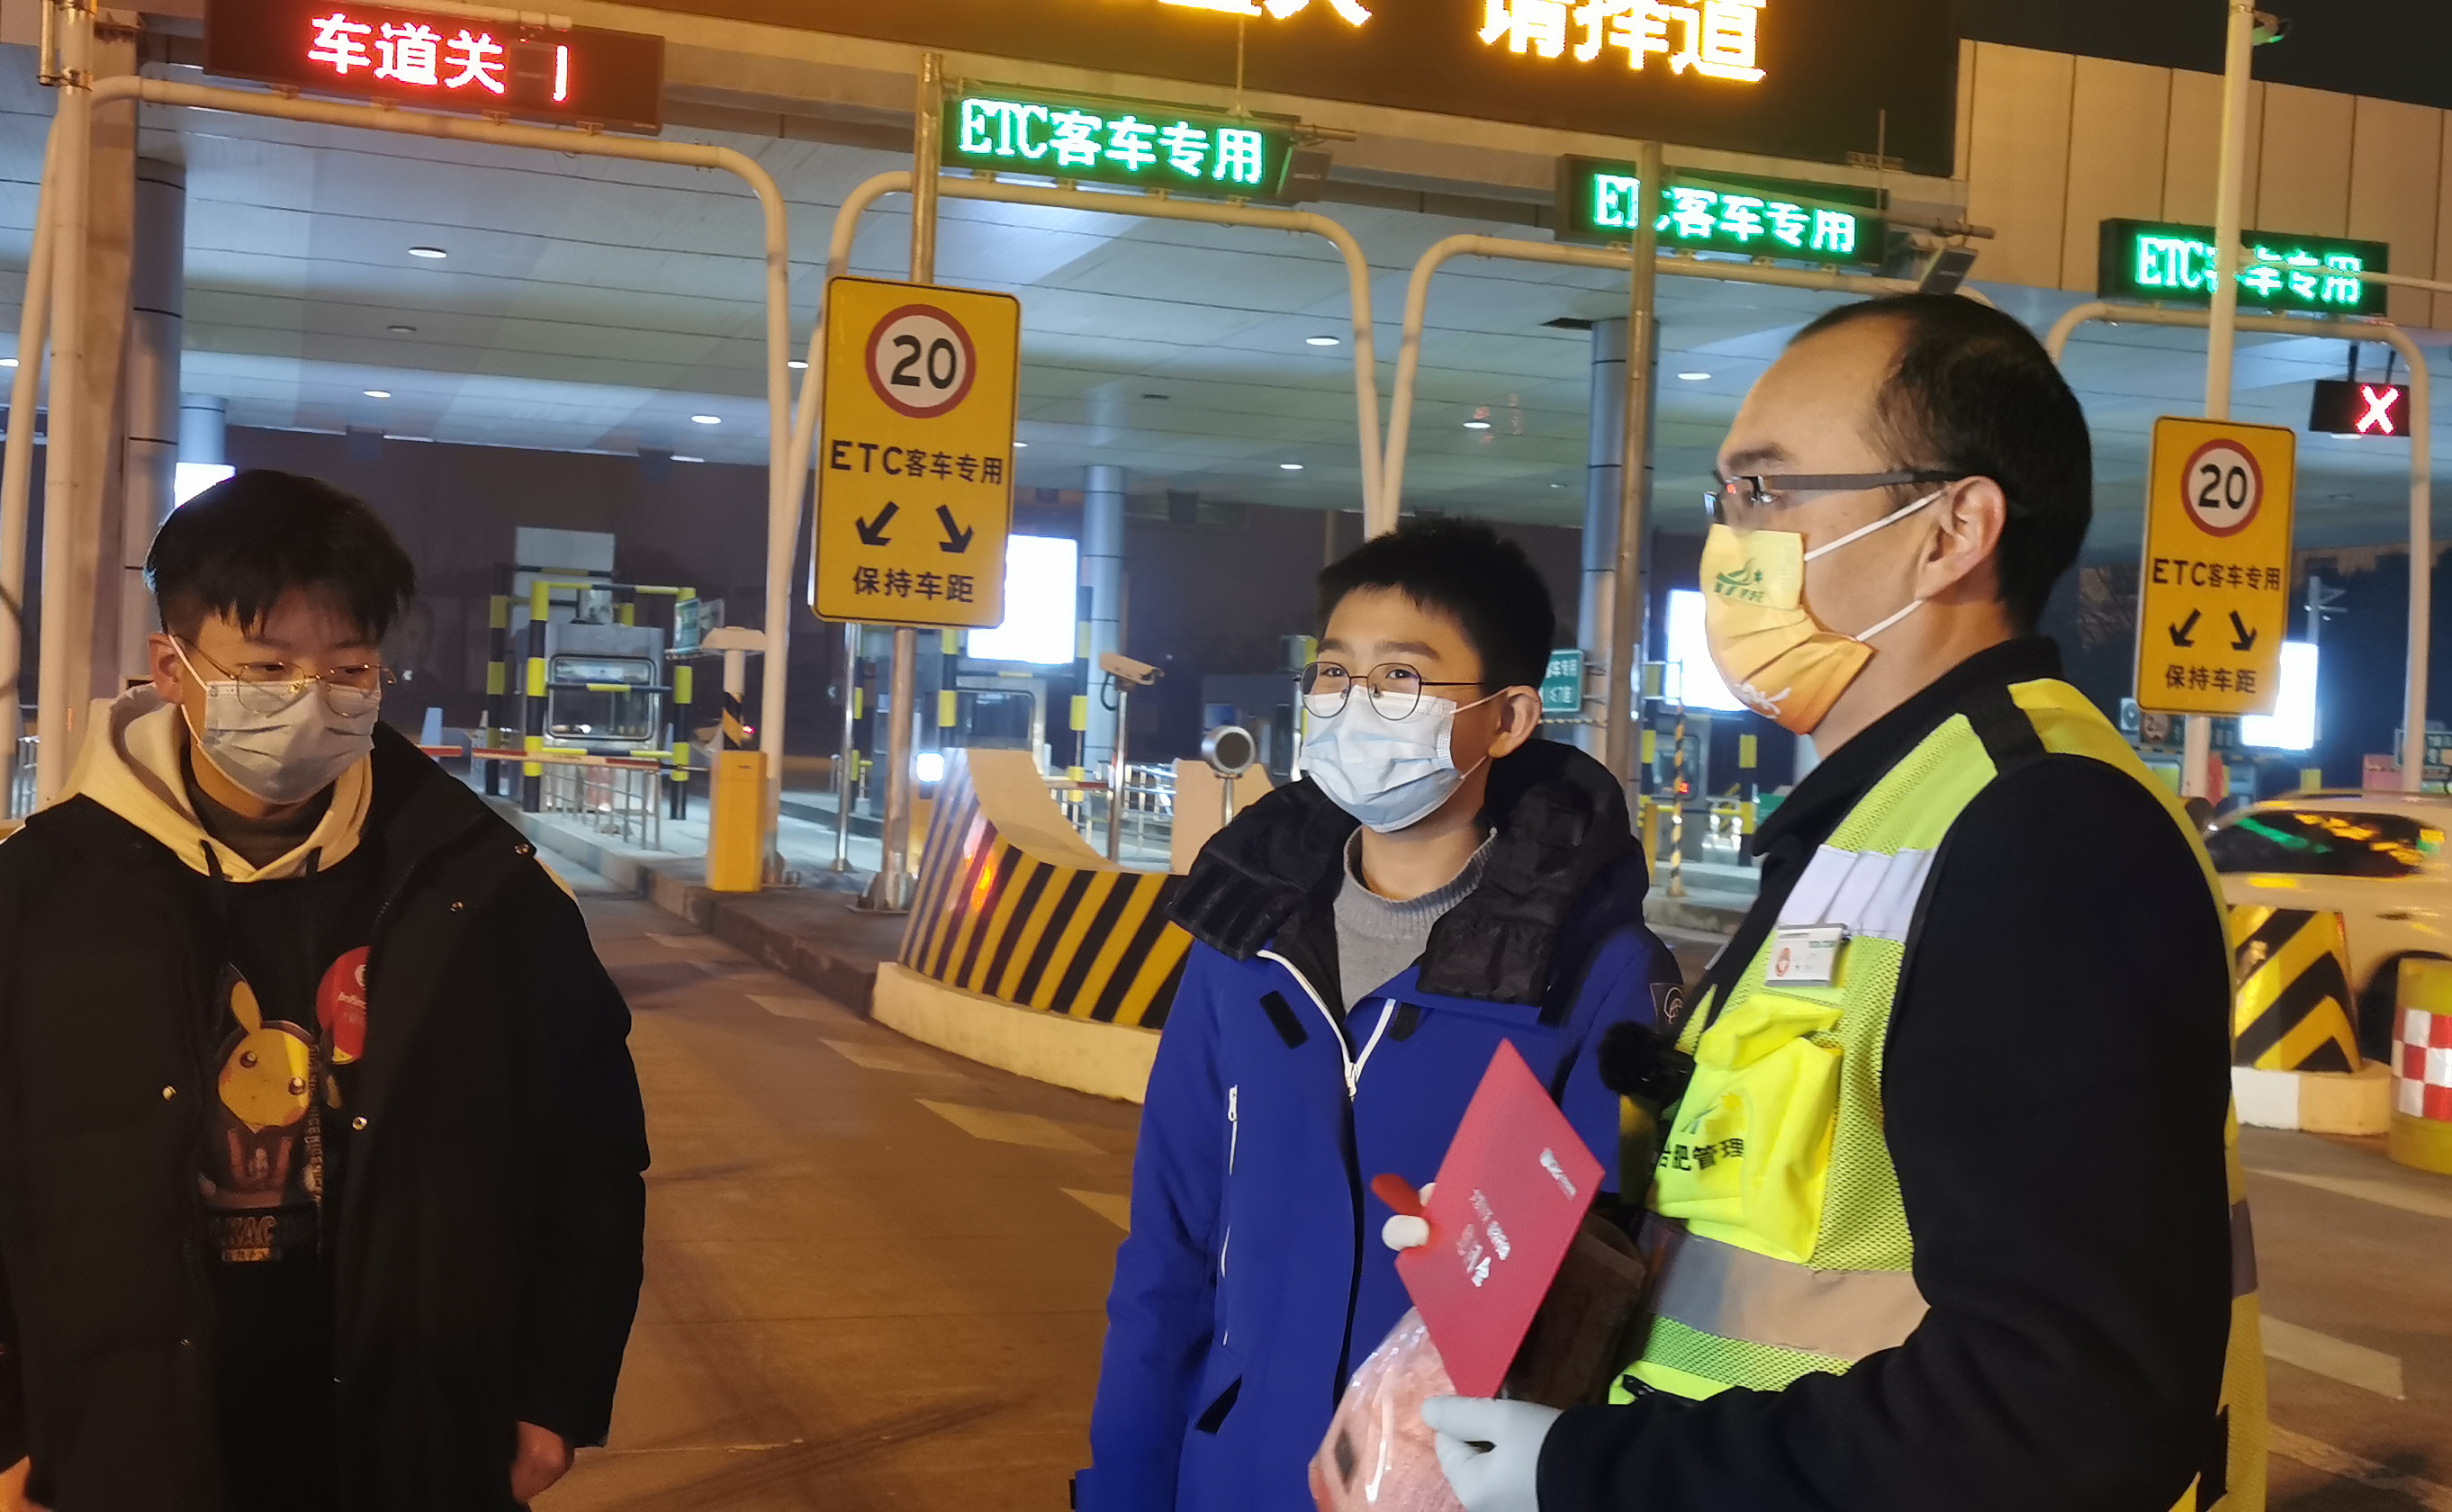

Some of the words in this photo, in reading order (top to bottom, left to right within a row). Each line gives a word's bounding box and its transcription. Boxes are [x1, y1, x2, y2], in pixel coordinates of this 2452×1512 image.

[308, 14, 569, 102] 车道关
[959, 97, 1262, 184] ETC客车专用
[1594, 173, 1856, 253] ET客车专用
[890, 335, 957, 389] 20
[830, 438, 1004, 485] ETC客车专用
[2198, 464, 2248, 509] 20
[852, 565, 974, 603] 保持车距
[2152, 557, 2281, 591] ETC客车专用
[2165, 664, 2257, 694] 保持车距
